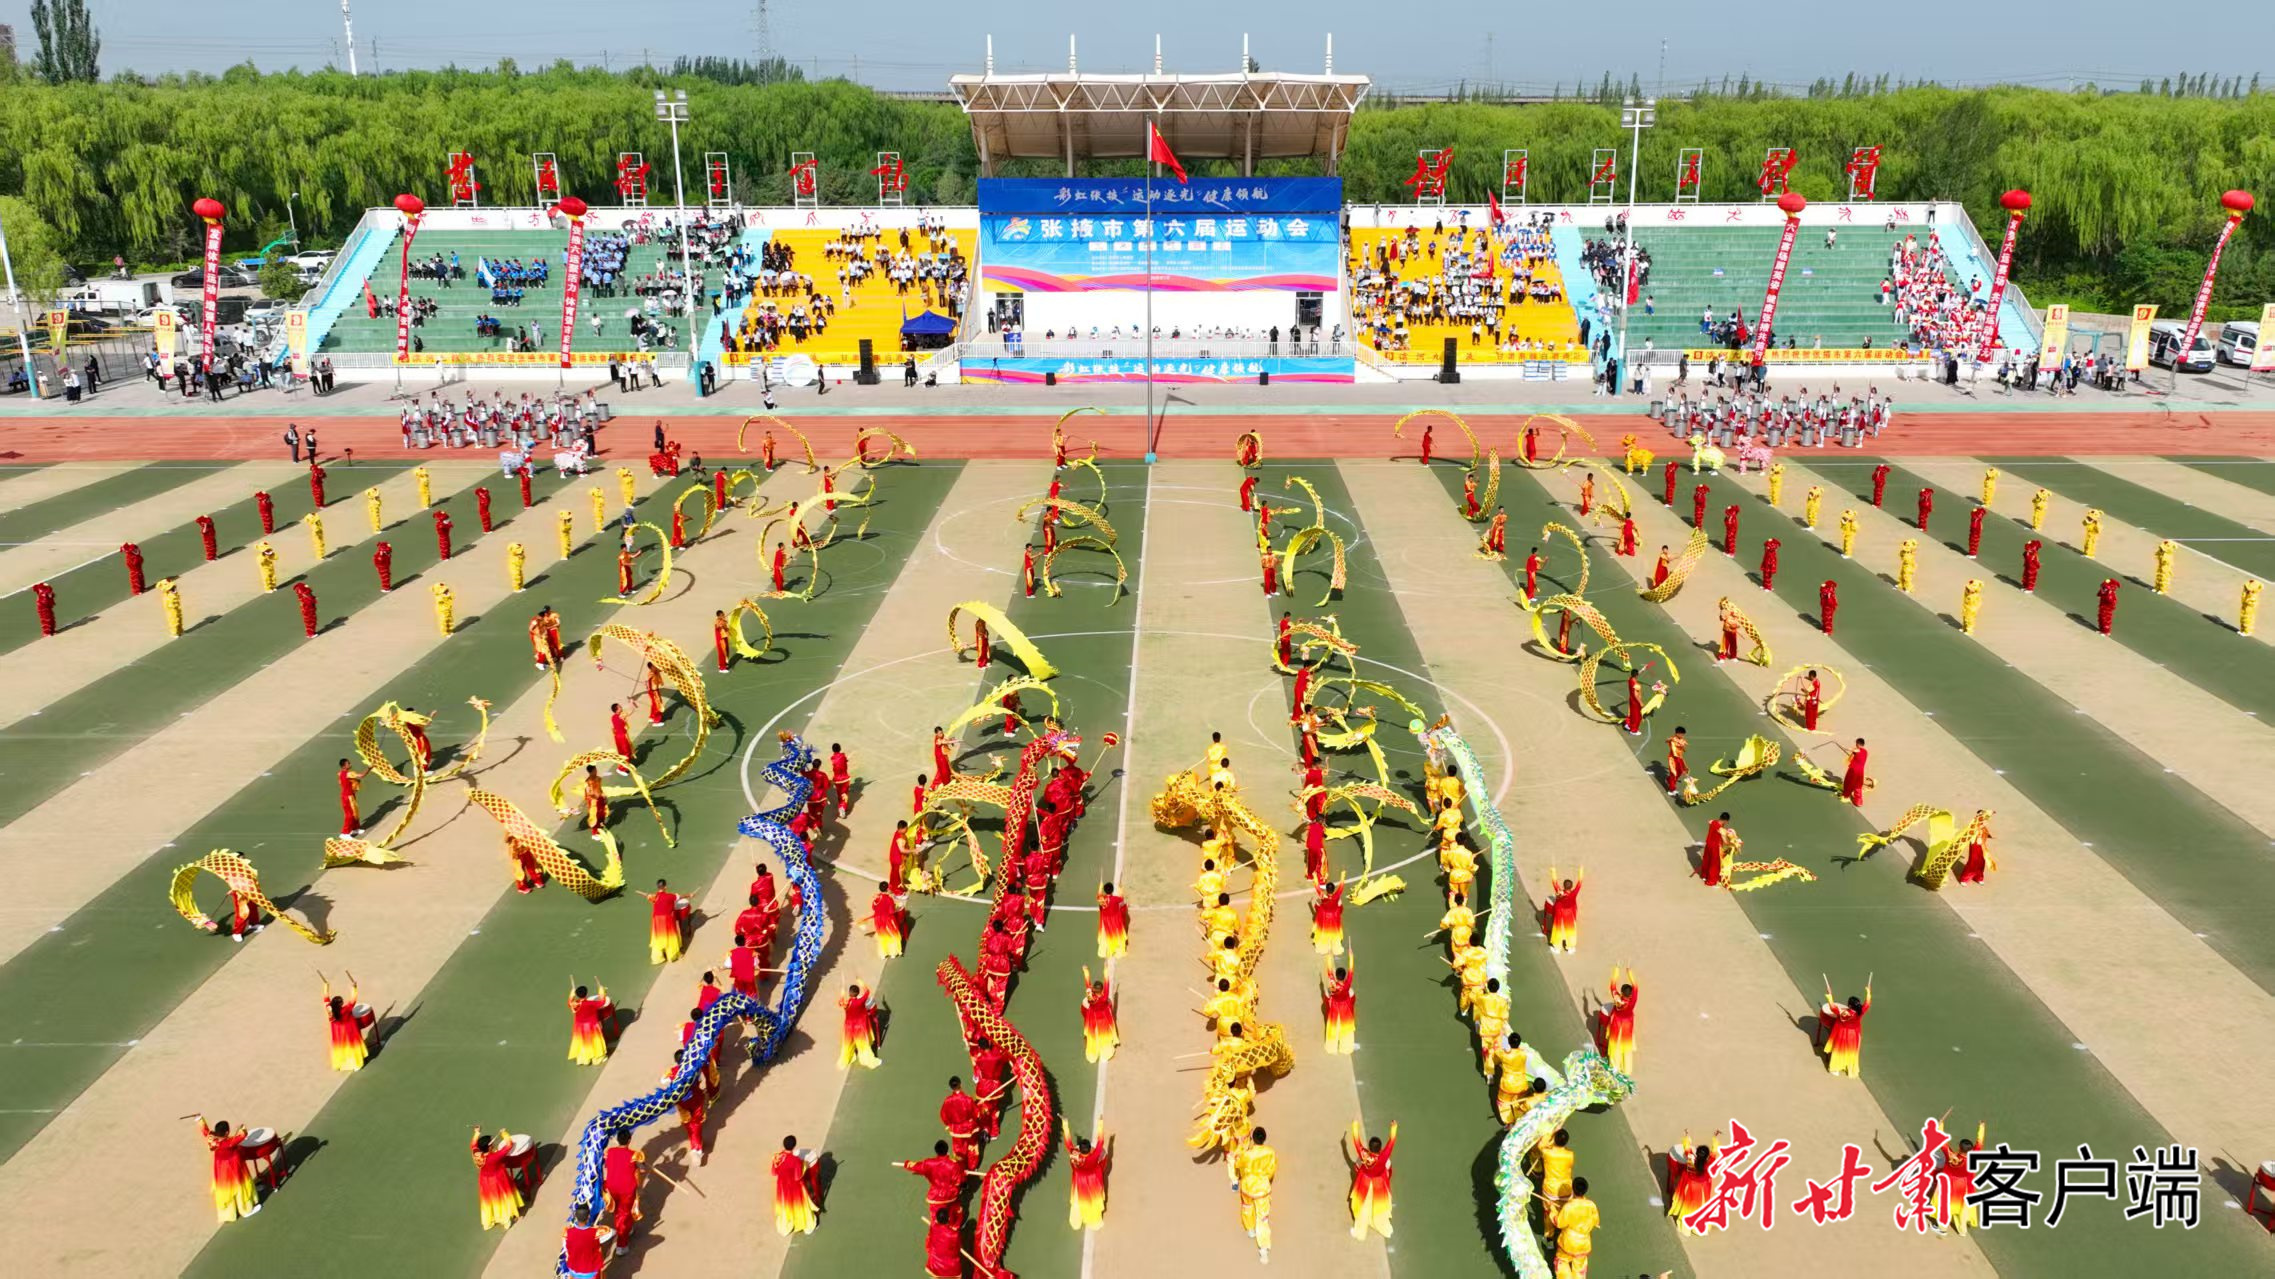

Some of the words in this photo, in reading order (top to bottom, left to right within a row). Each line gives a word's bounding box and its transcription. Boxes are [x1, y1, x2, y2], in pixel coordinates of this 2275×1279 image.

[1040, 218, 1310, 238] 张掖市第六届运动会
